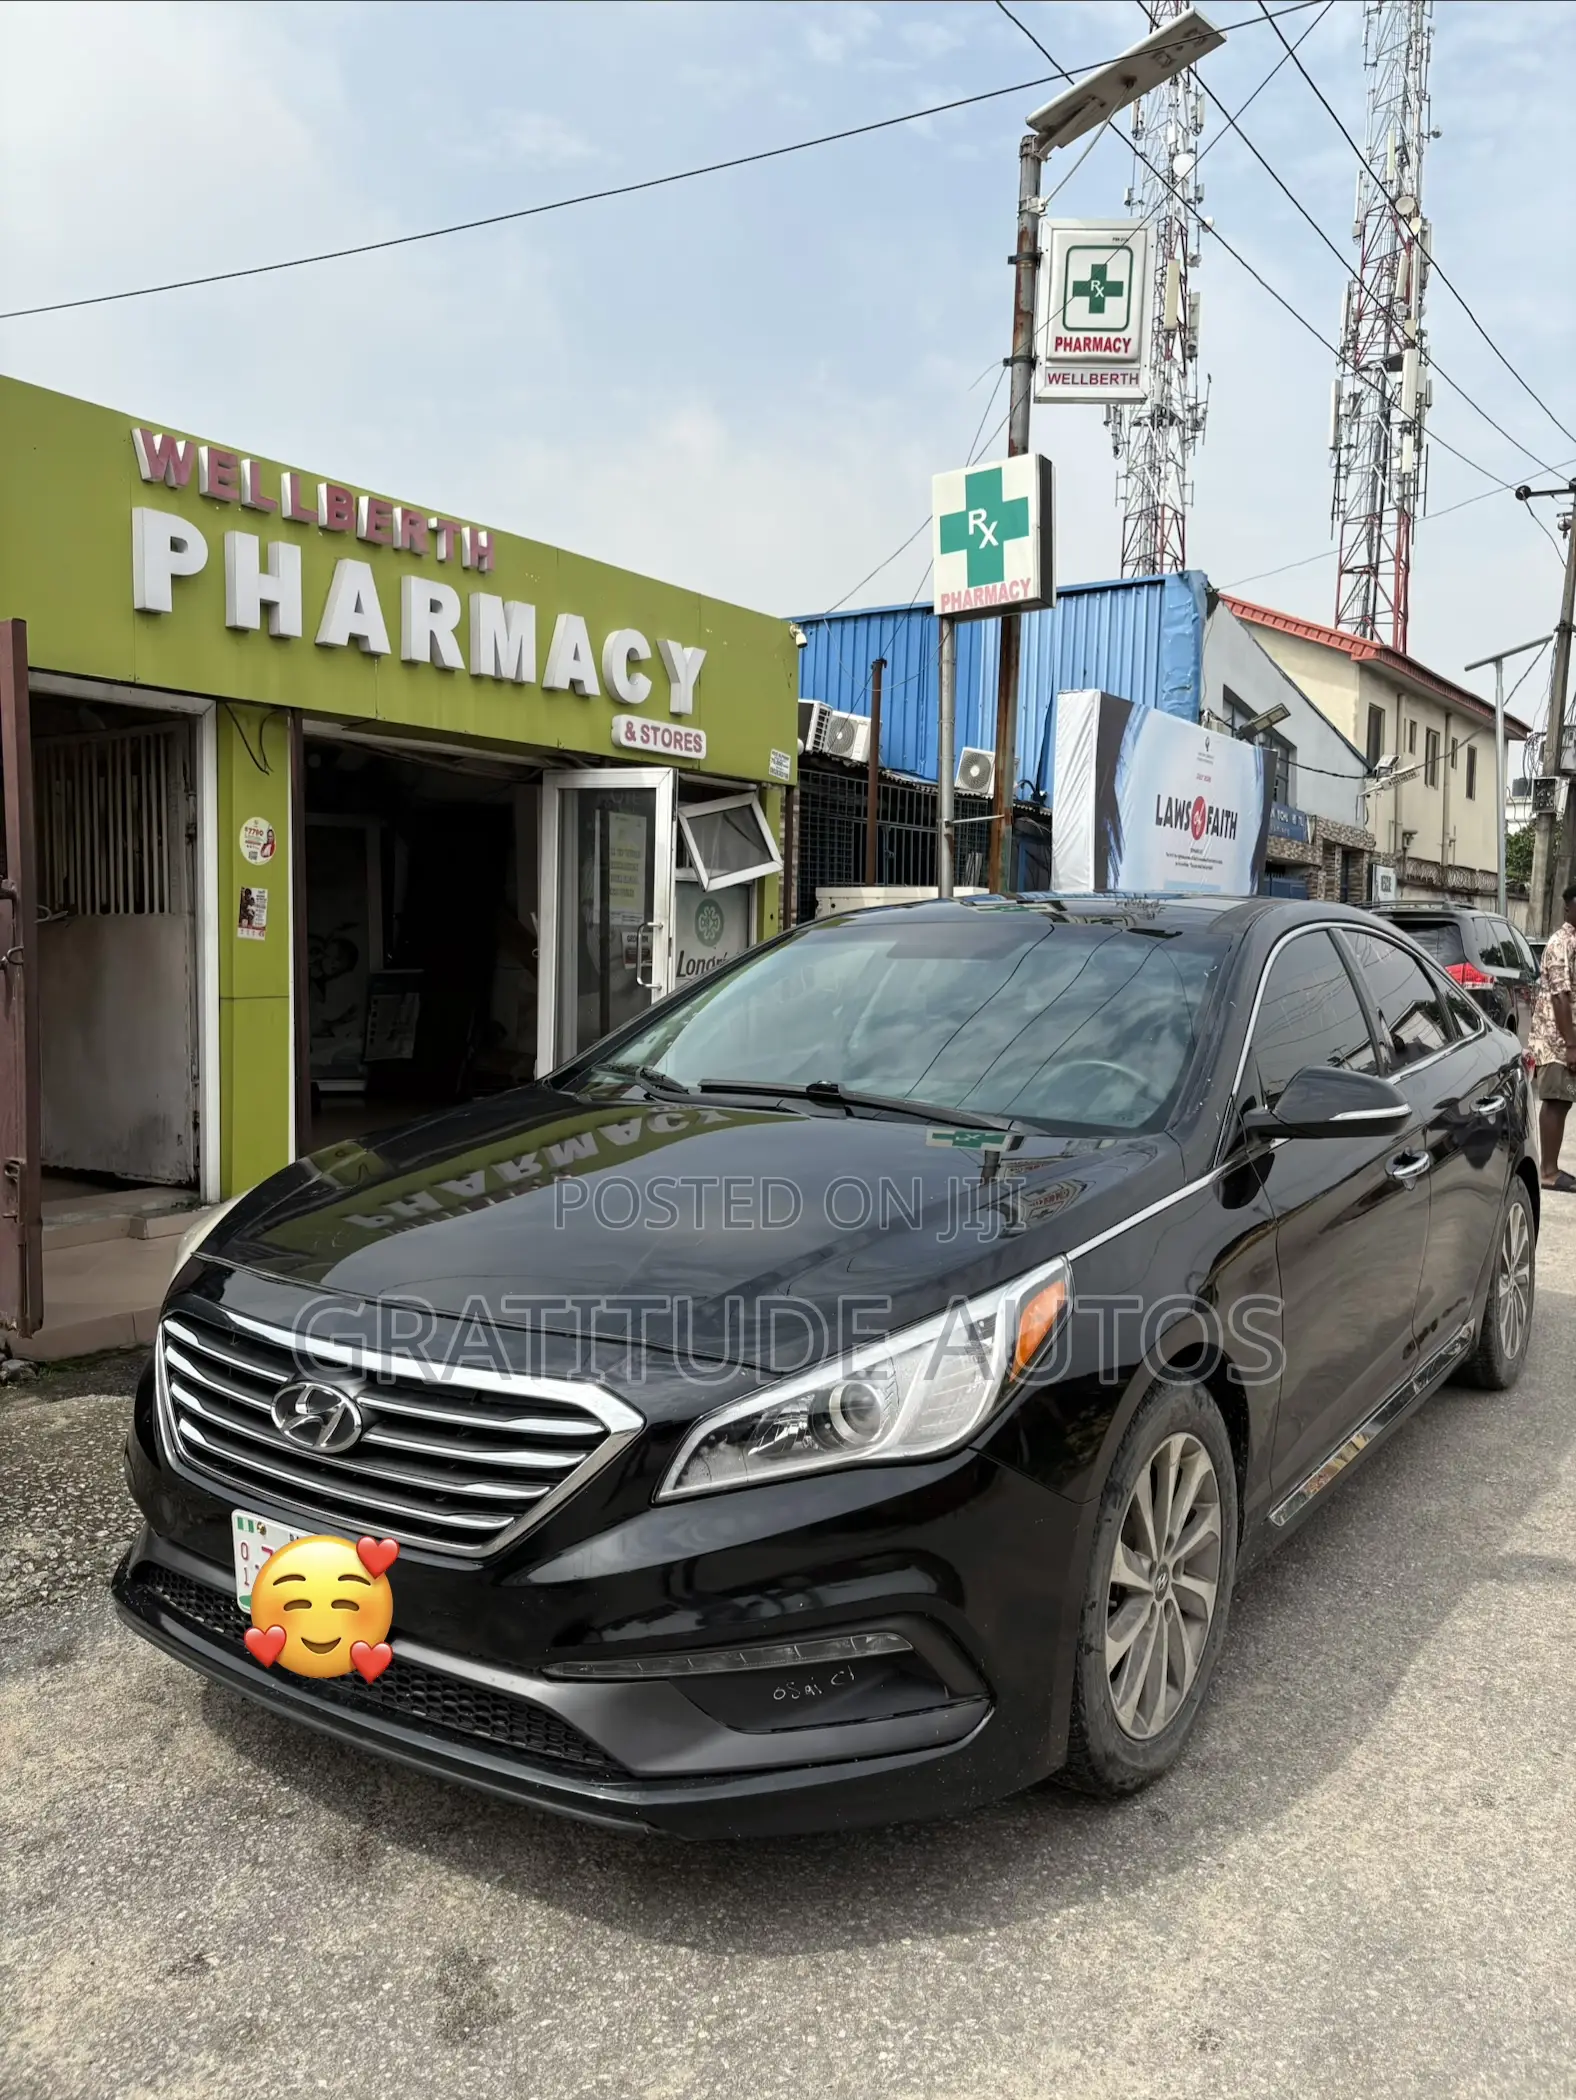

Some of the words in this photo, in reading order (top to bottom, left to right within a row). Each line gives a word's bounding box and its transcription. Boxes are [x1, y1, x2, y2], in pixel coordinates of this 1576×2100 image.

[1054, 336, 1132, 354] PHARMACY
[1047, 371, 1139, 387] WELLBERTH
[131, 427, 495, 574] WELLBERTH
[131, 506, 707, 715] PHARMACY
[940, 577, 1031, 613] PHARMACY
[625, 720, 636, 742] &
[640, 723, 703, 753] STORES
[1155, 793, 1192, 832] LAWS
[1205, 805, 1238, 840] FAITH
